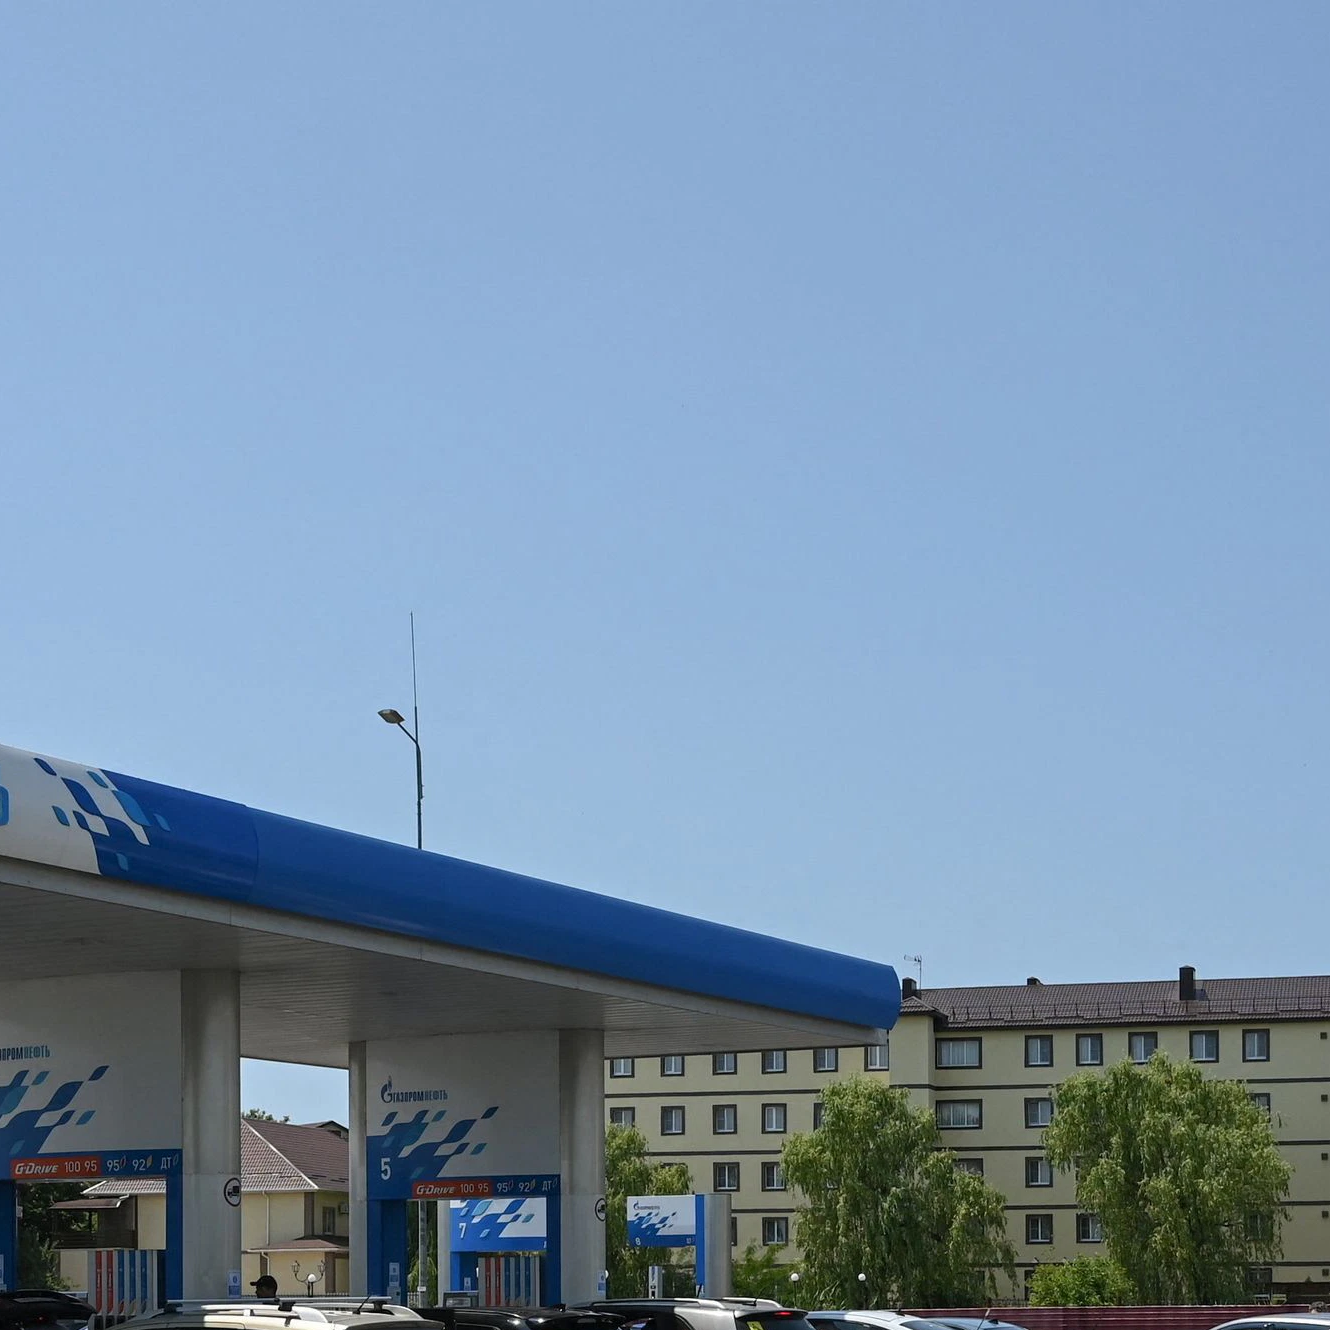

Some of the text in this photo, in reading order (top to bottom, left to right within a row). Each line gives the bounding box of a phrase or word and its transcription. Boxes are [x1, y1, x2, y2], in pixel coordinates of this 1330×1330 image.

[391, 1090, 448, 1103] ГАЗПРОМНЕФТЬ
[64, 1161, 81, 1173] 100
[84, 1160, 97, 1172] 95
[106, 1160, 120, 1172] 95
[132, 1159, 146, 1171] 92
[160, 1157, 172, 1170] ДТ
[380, 1158, 391, 1180] 5
[460, 1183, 474, 1193] 100
[477, 1183, 489, 1193] 95
[496, 1183, 508, 1192] 95
[518, 1182, 531, 1192] 92
[458, 1222, 466, 1239] 7
[635, 1237, 641, 1246] 8
